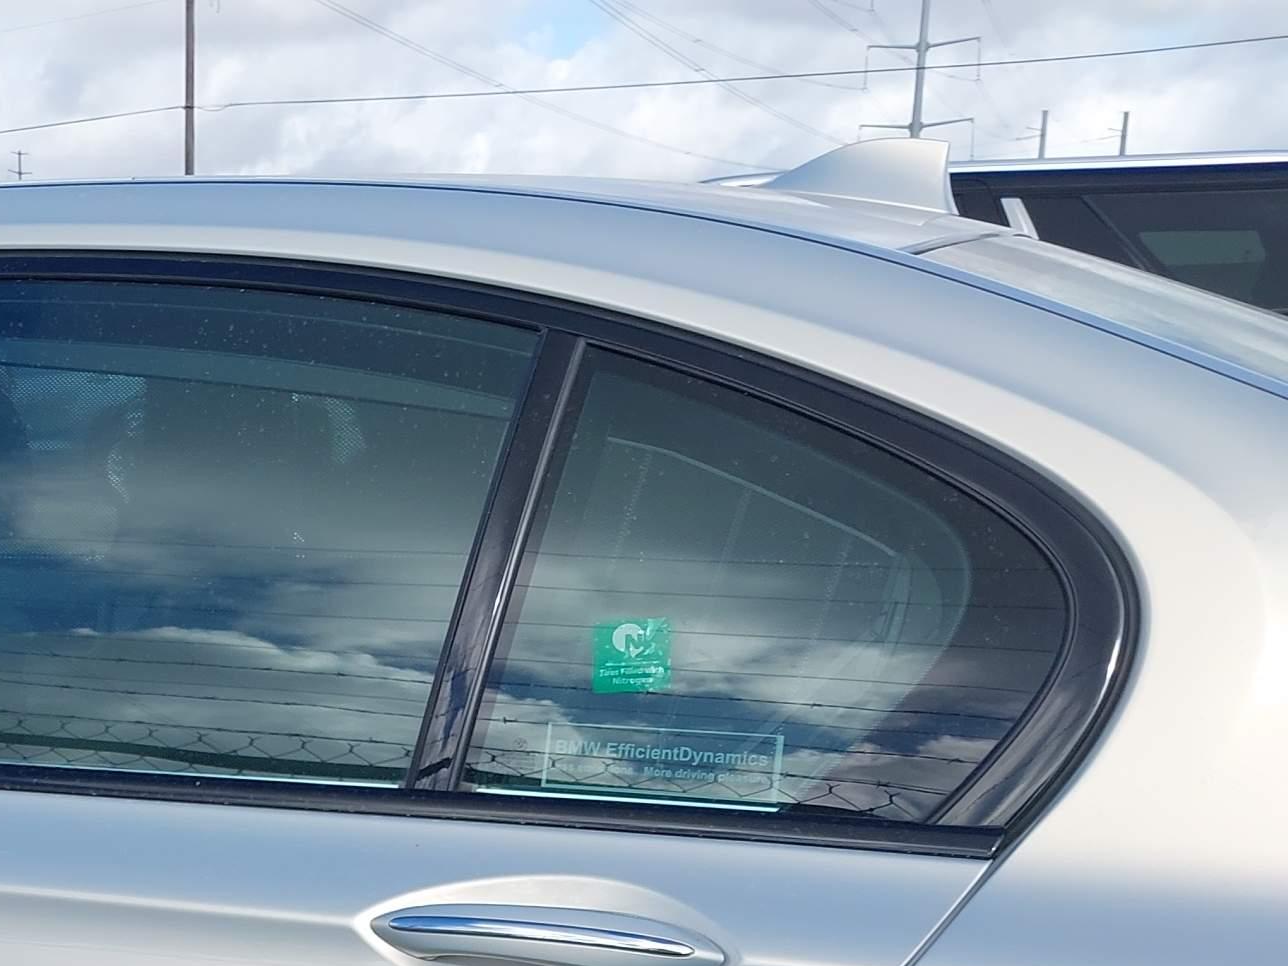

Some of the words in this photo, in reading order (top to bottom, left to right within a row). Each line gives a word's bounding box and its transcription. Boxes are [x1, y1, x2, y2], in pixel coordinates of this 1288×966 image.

[556, 739, 600, 756] BMW
[607, 742, 769, 767] EfficientDynamics
[643, 767, 672, 778] More
